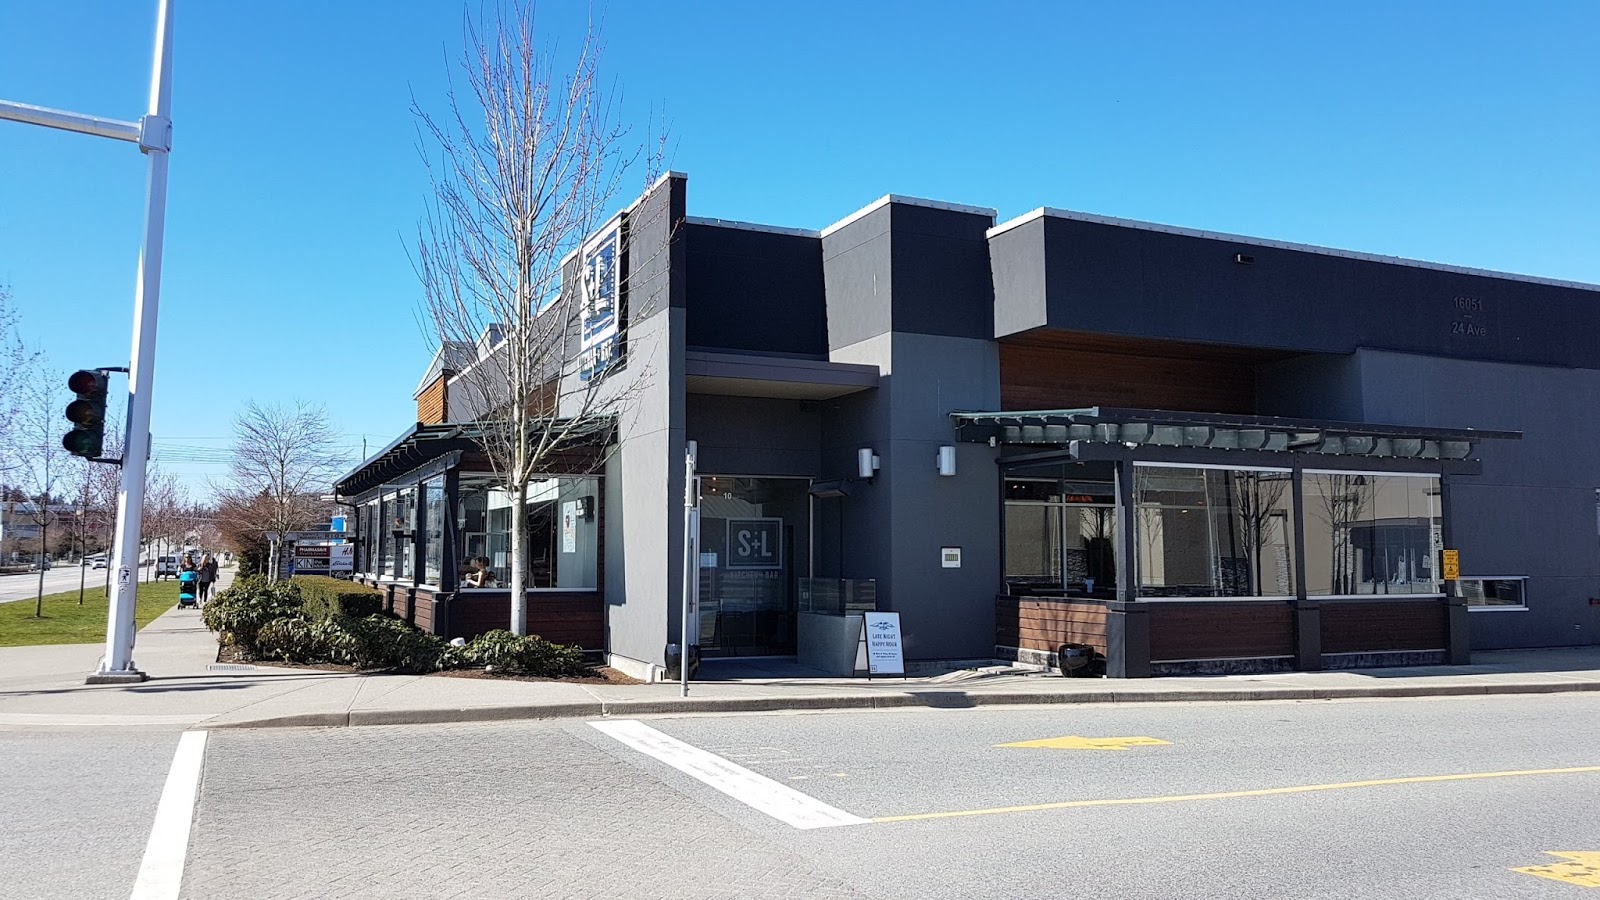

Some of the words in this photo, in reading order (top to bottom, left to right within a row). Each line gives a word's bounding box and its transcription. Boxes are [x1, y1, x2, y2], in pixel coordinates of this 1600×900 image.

[1453, 297, 1482, 310] 16051
[1452, 321, 1465, 334] 24
[1467, 323, 1486, 336] Ave
[723, 492, 732, 500] 10
[765, 571, 778, 579] BAR
